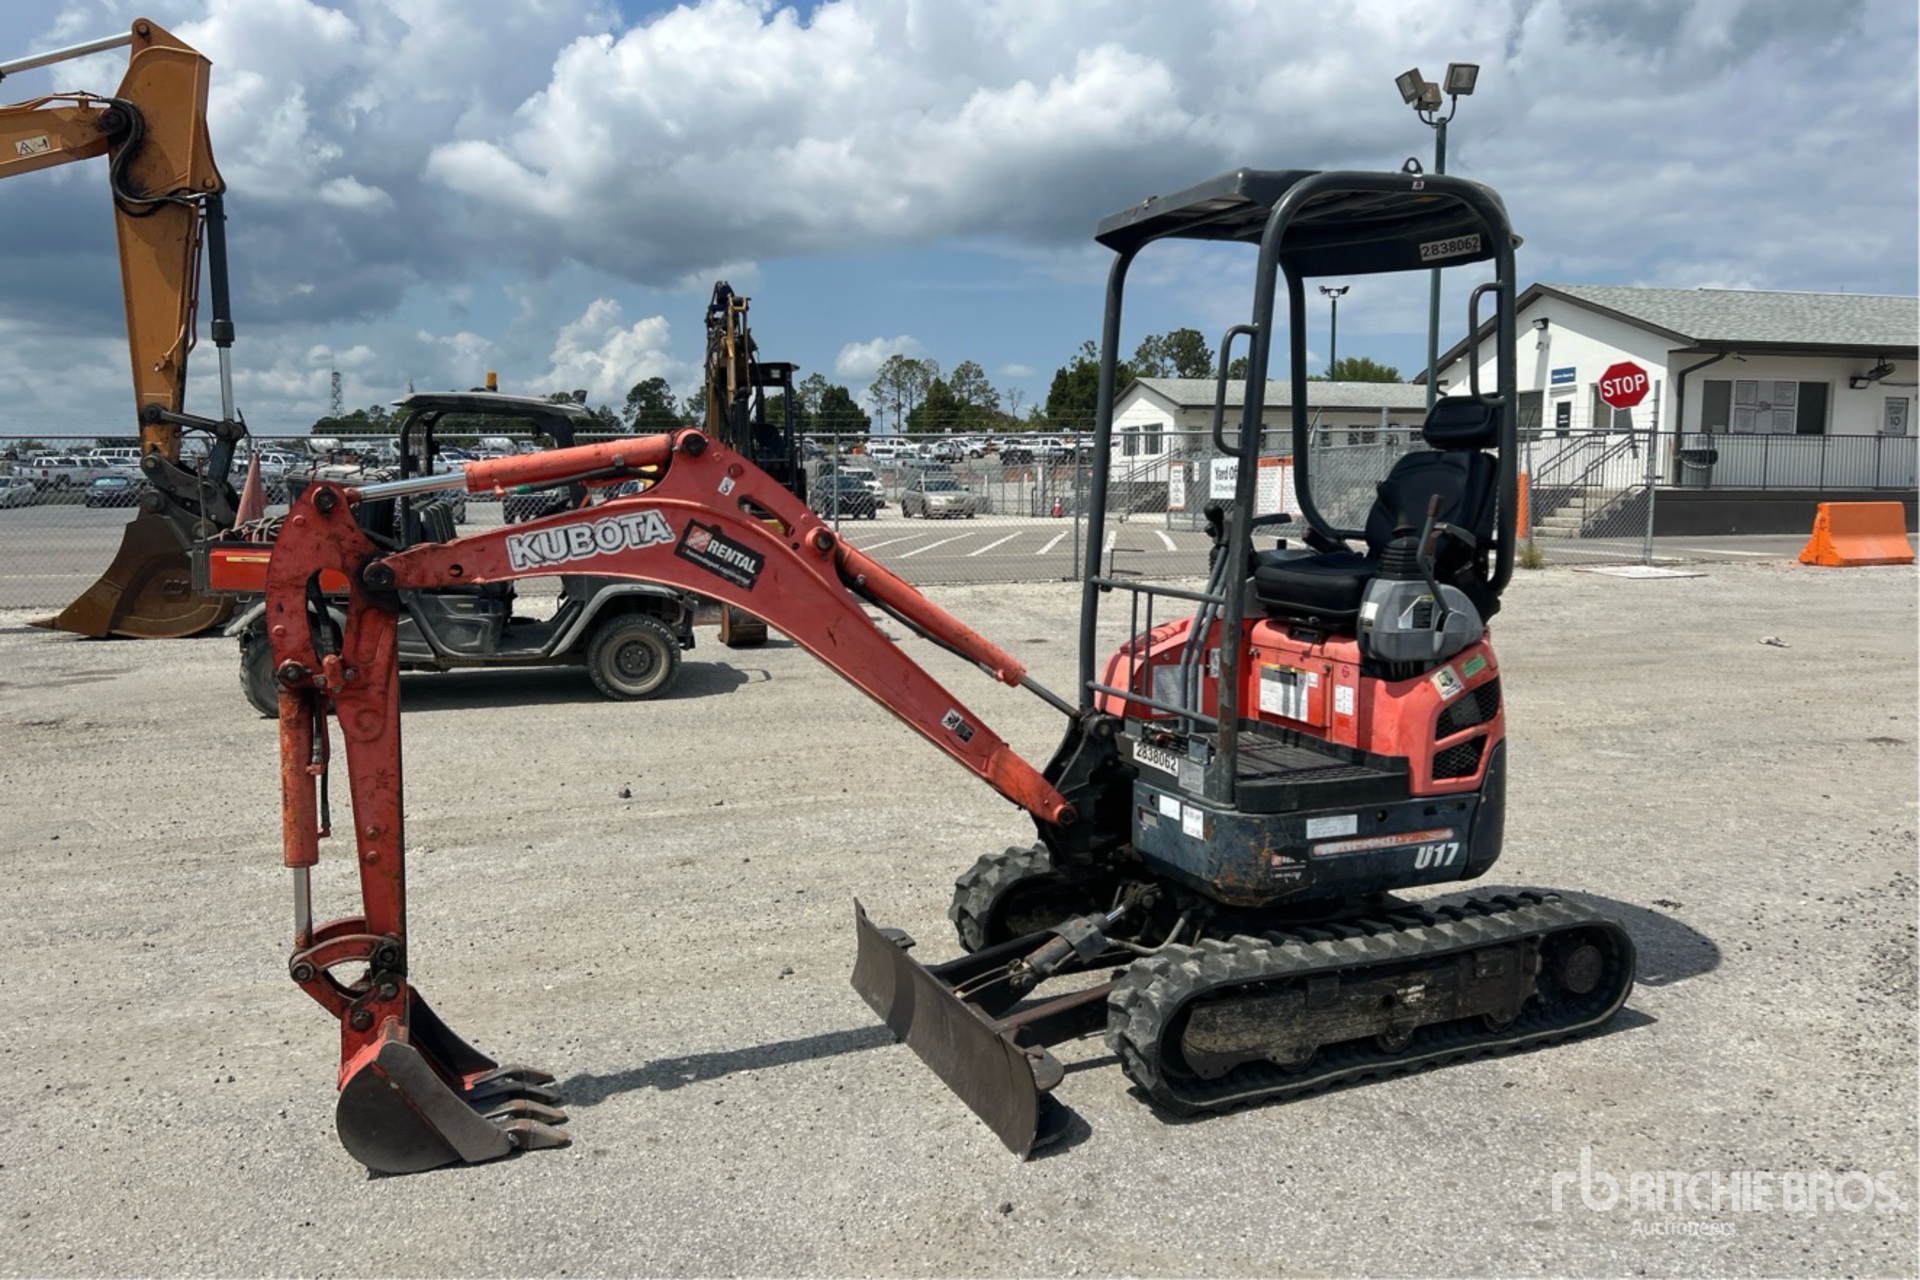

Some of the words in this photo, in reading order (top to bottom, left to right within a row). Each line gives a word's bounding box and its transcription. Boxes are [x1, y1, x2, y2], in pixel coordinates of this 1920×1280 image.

[1422, 236, 1479, 257] 2838062
[1602, 373, 1646, 398] STOP
[1215, 466, 1228, 480] Yard
[507, 511, 674, 570] KUBOTA
[707, 538, 756, 574] RENTAL
[1136, 743, 1177, 772] 2838062
[1414, 842, 1460, 870] U17
